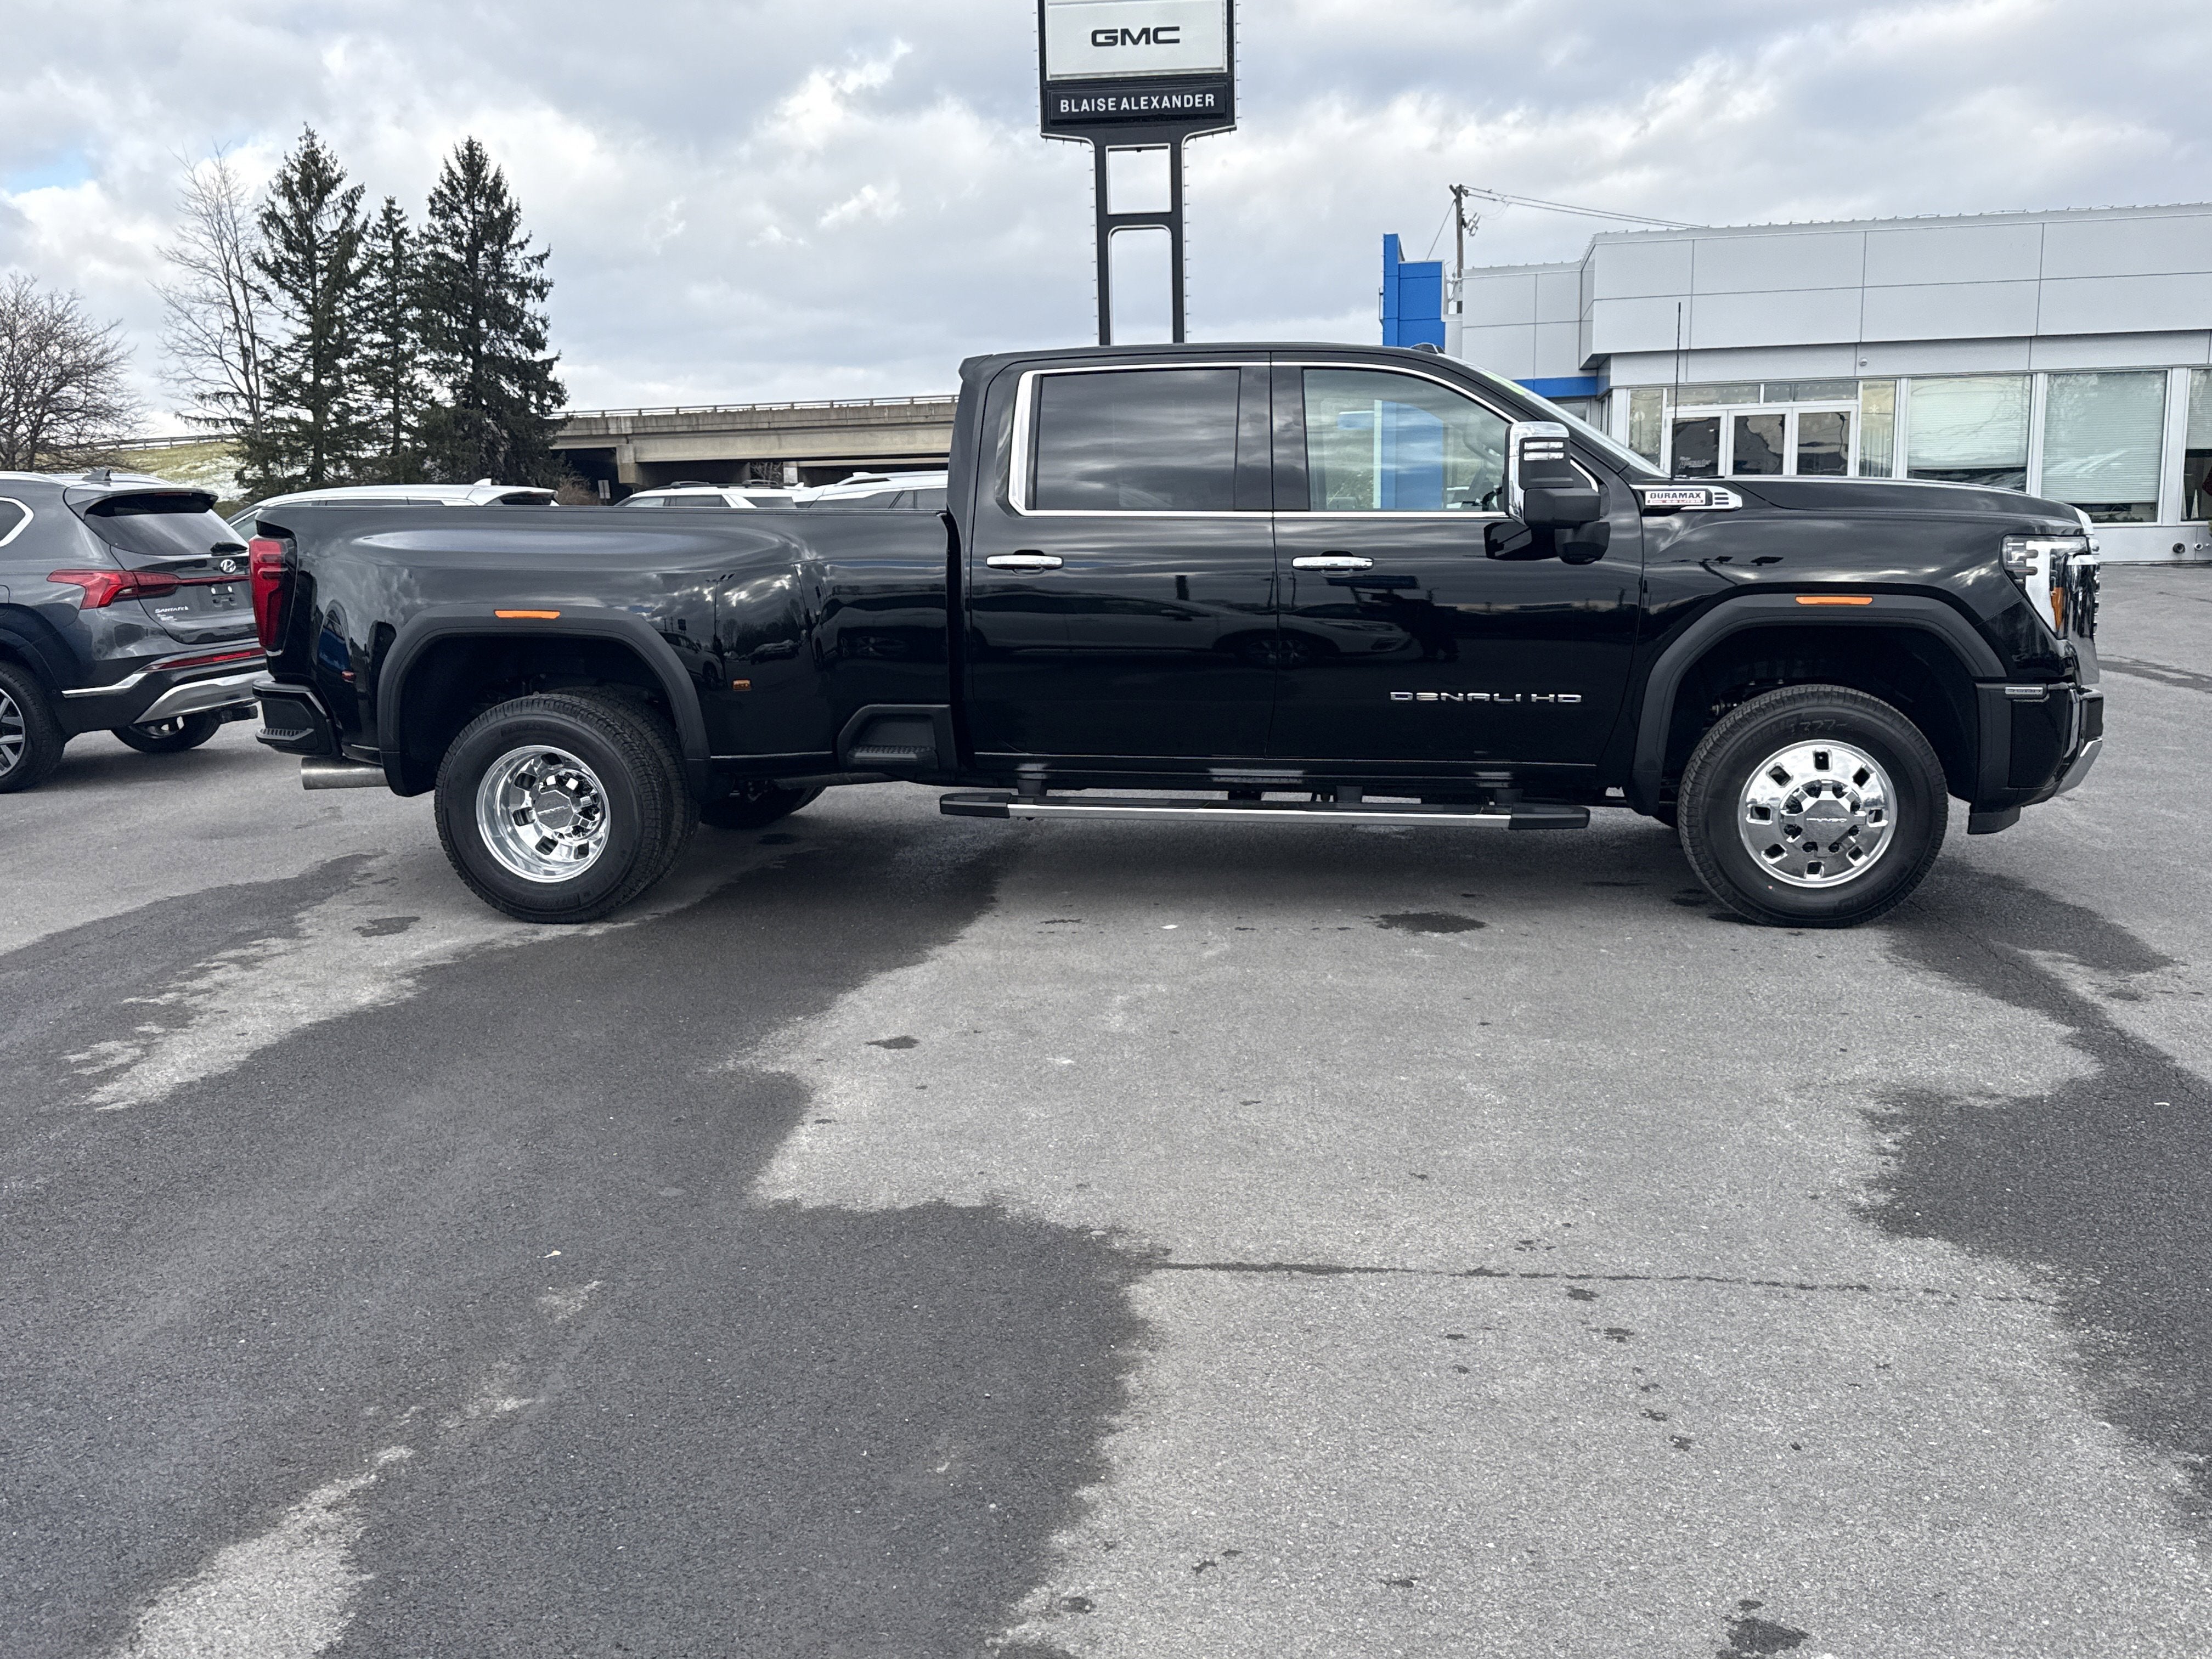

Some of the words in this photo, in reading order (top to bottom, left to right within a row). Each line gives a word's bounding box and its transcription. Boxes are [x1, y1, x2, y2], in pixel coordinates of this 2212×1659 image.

[1091, 26, 1181, 47] GMC
[1059, 97, 1117, 113] BLAISE
[1120, 93, 1215, 111] ALEXANDER
[1390, 691, 1522, 703] DENALI
[1531, 693, 1582, 703] HD
